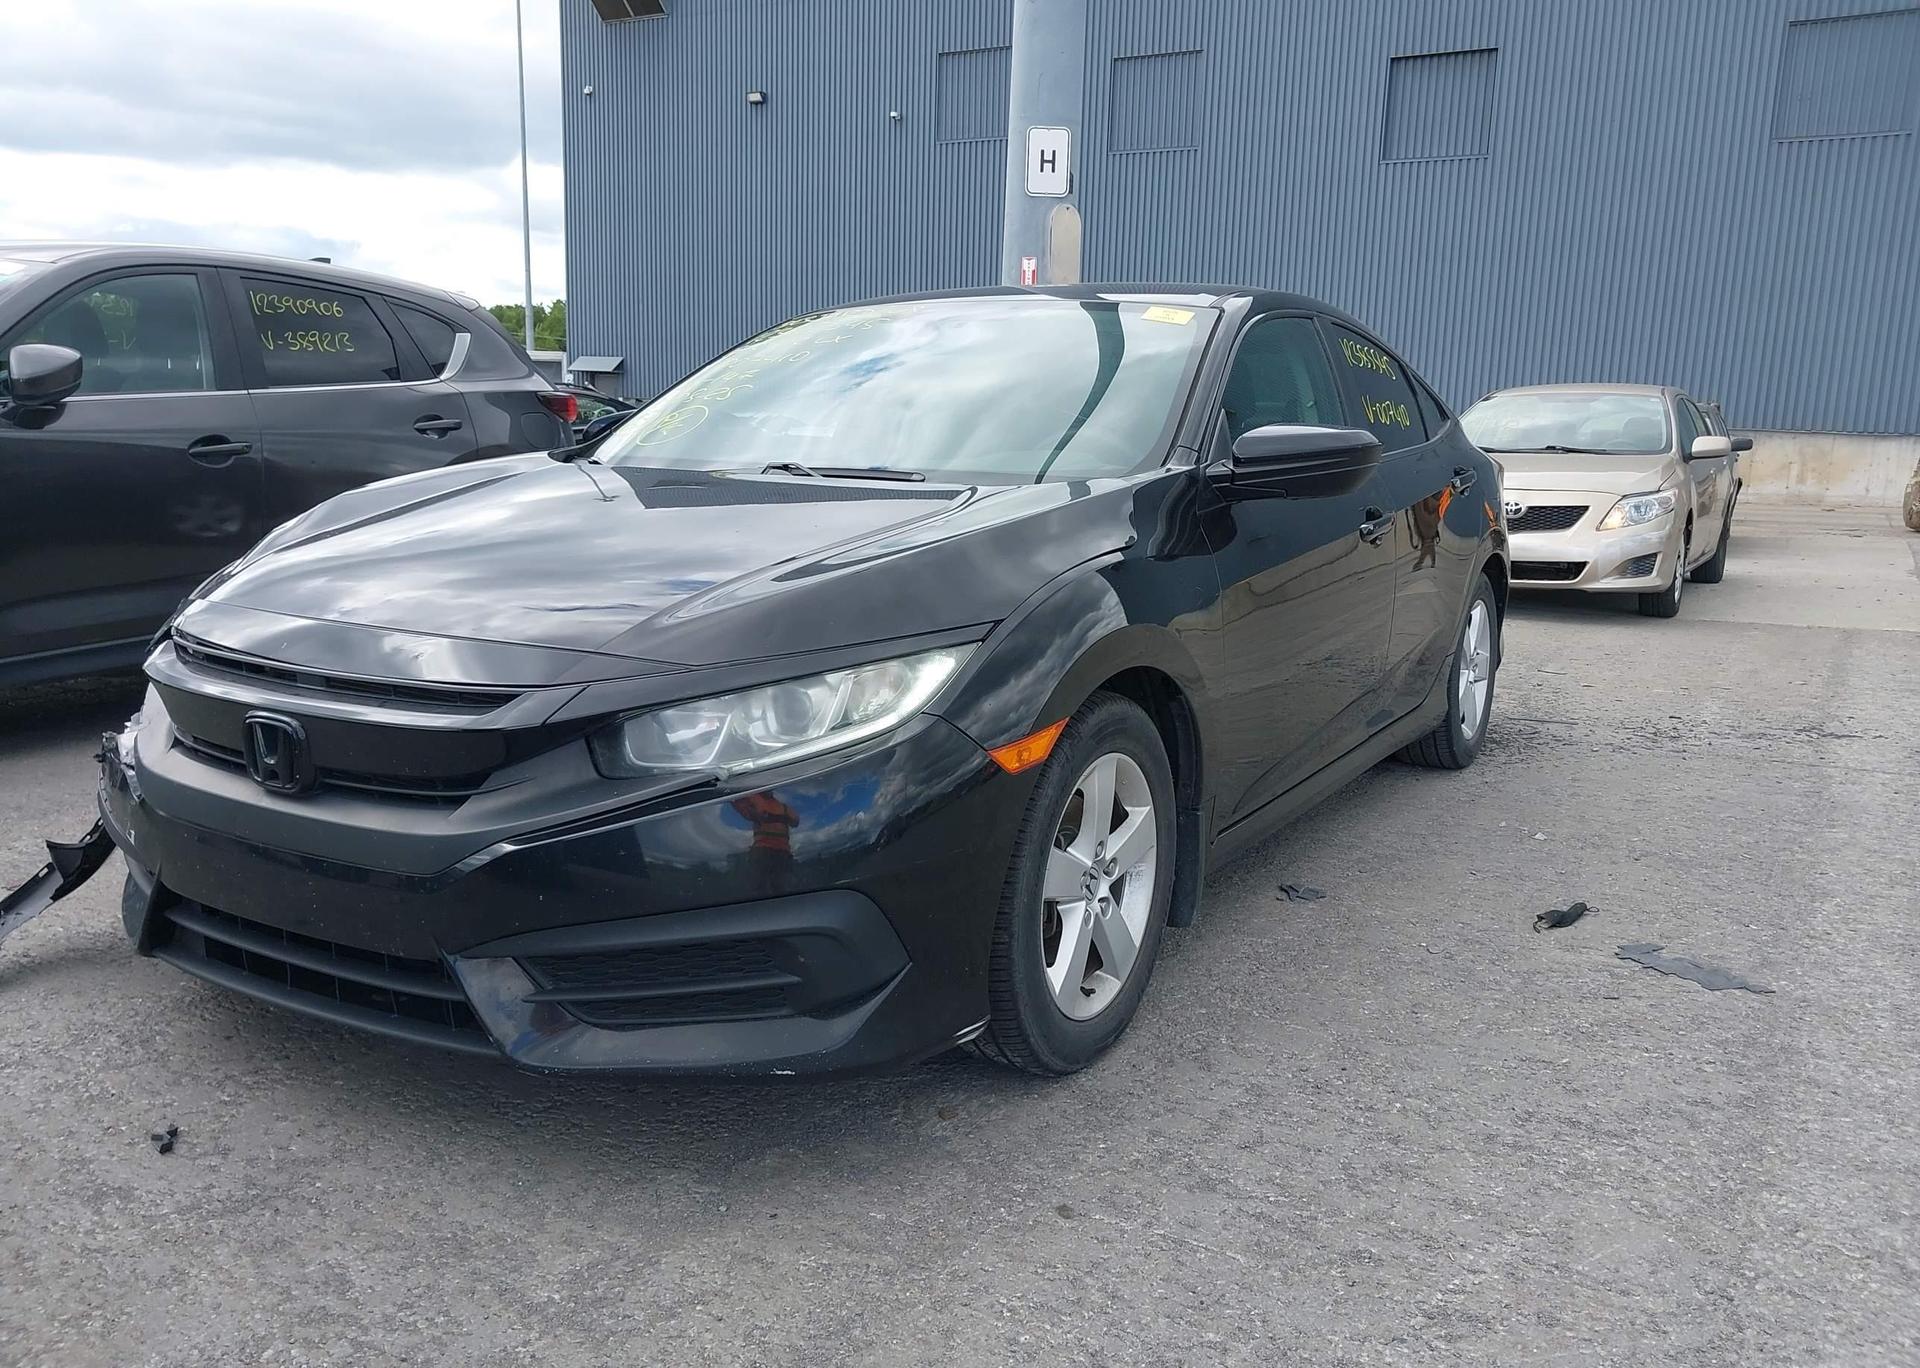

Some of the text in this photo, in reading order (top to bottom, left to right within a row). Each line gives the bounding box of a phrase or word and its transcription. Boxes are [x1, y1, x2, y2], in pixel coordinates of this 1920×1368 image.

[1039, 149, 1057, 173] H
[249, 290, 344, 318] 12390906
[260, 330, 355, 353] V-389213
